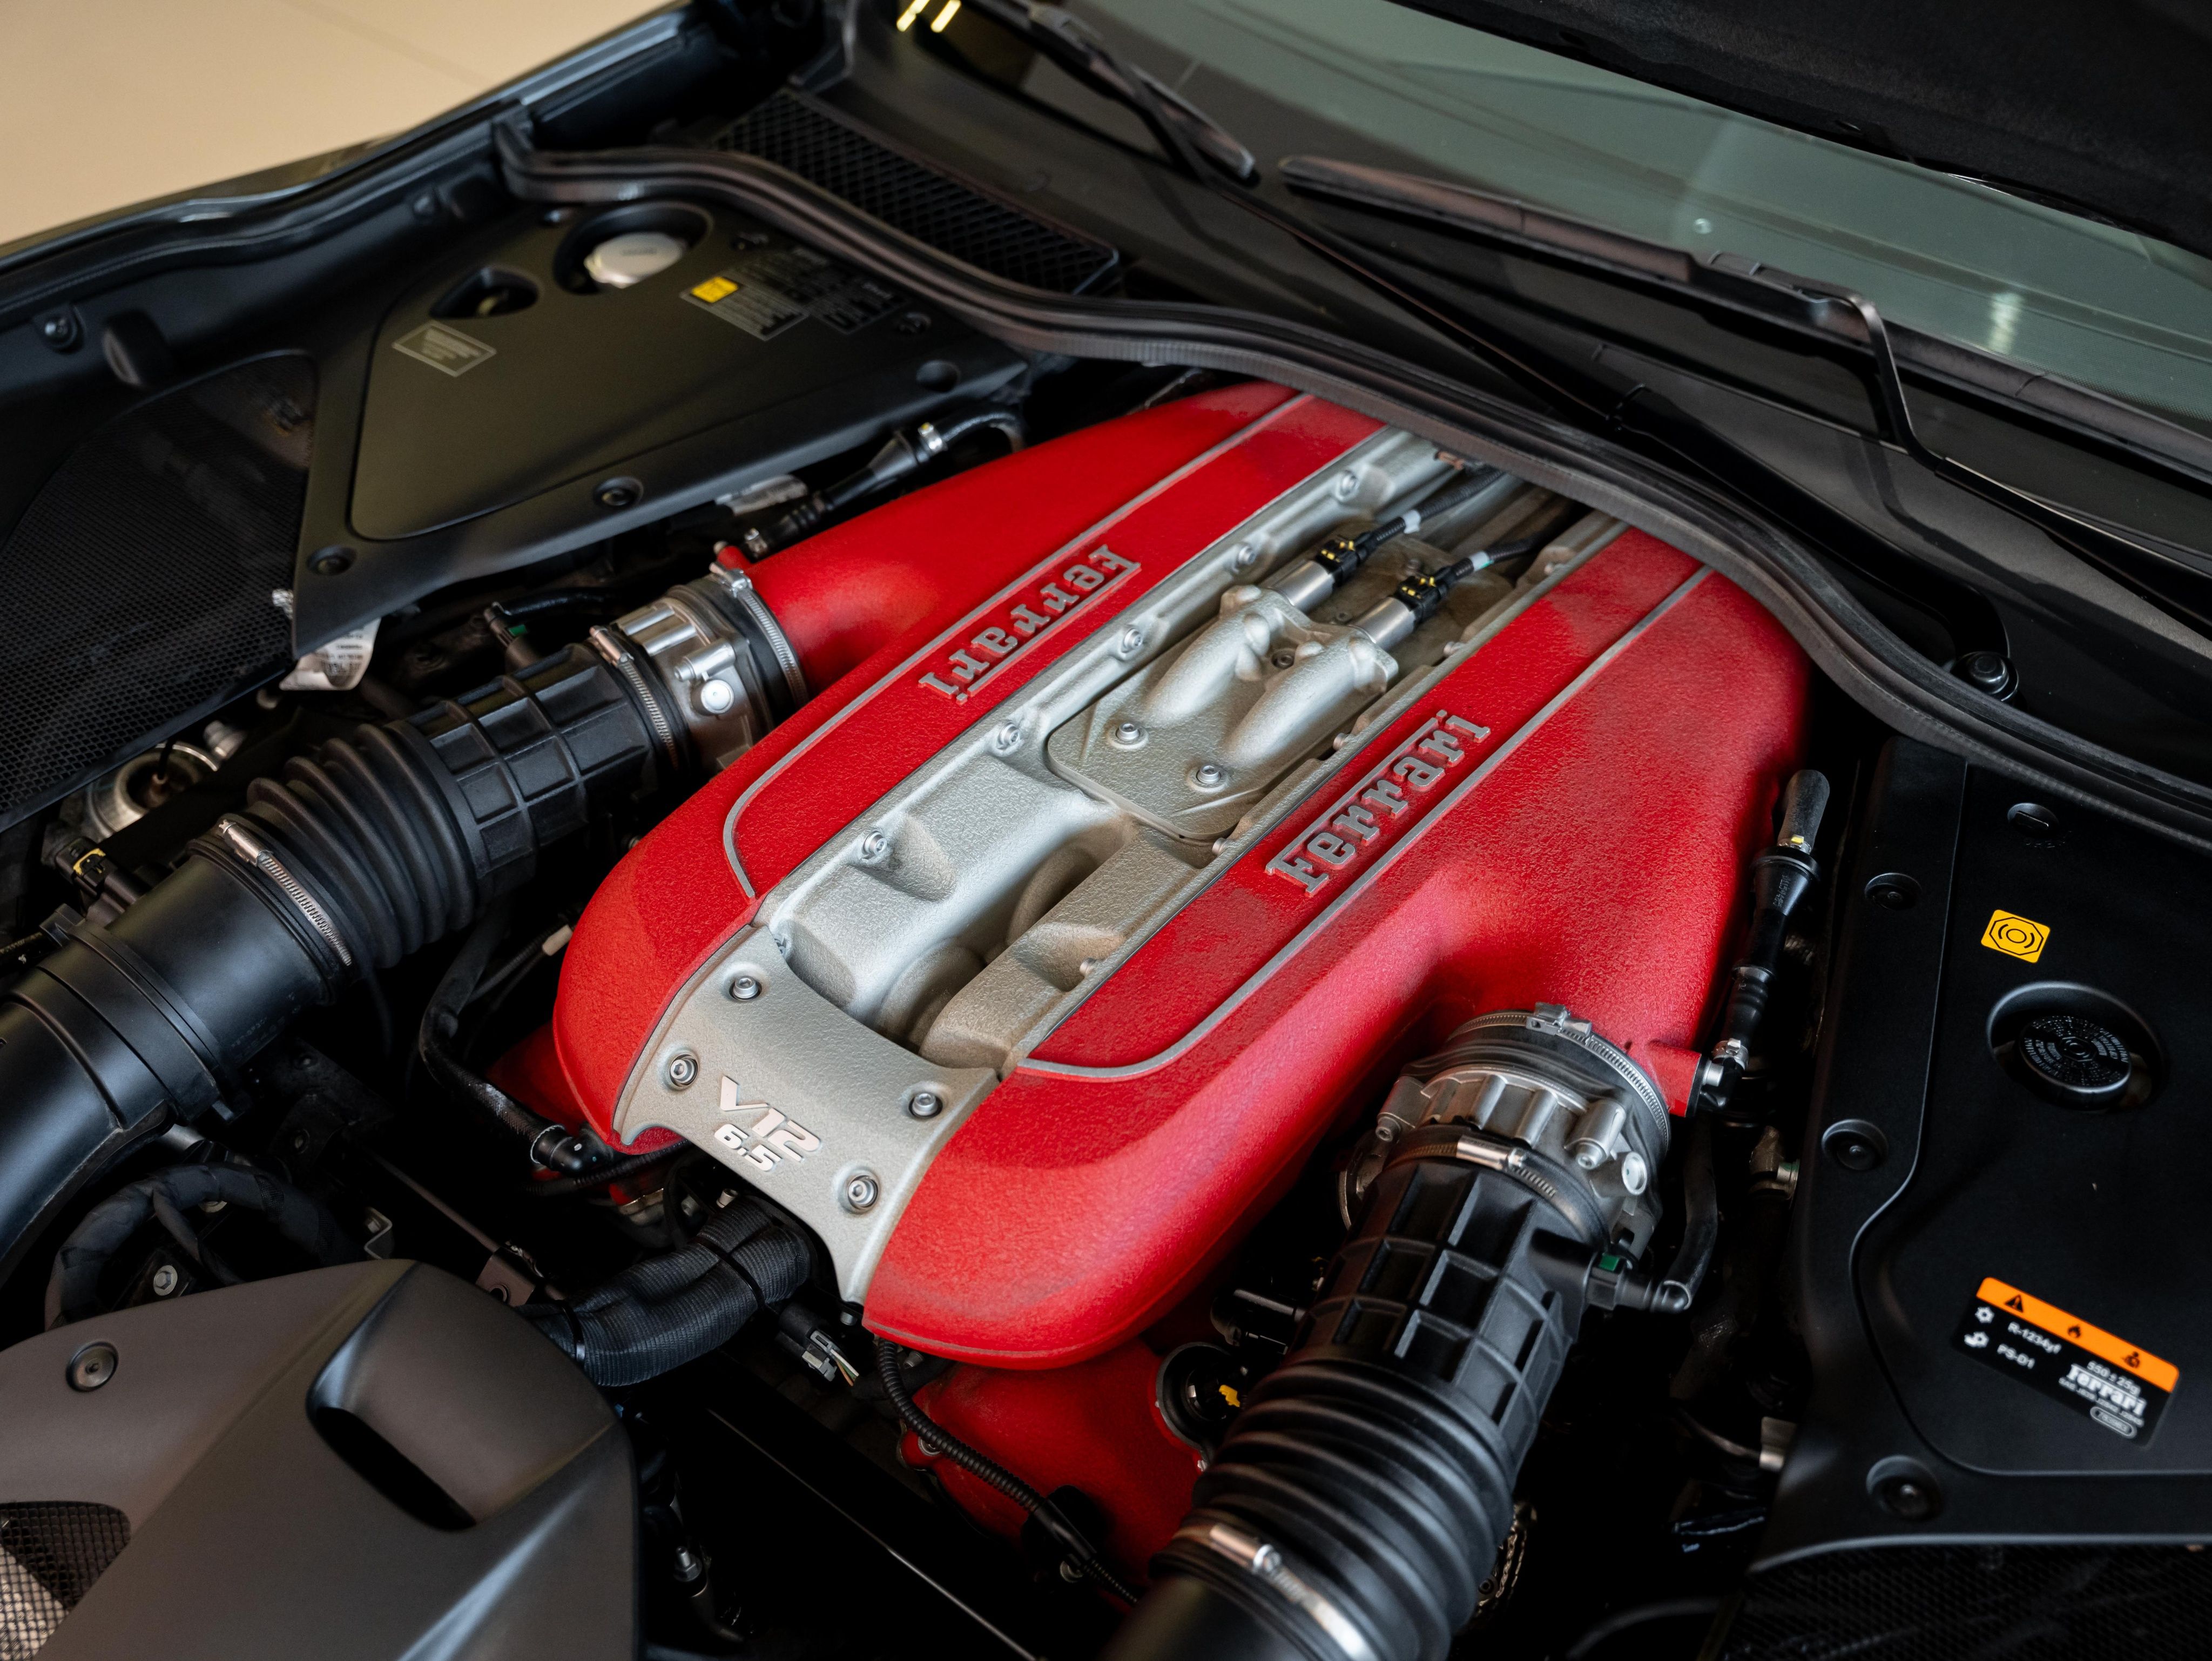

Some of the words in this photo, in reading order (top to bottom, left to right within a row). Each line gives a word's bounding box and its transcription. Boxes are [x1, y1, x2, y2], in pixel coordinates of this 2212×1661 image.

[919, 544, 1142, 705] Ferrari
[1265, 709, 1491, 897] Ferrari
[714, 1124, 783, 1172] 6.5
[719, 1075, 822, 1162] V12
[2008, 1322, 2062, 1354] R-1234yf
[2066, 1363, 2147, 1417] Ferrari
